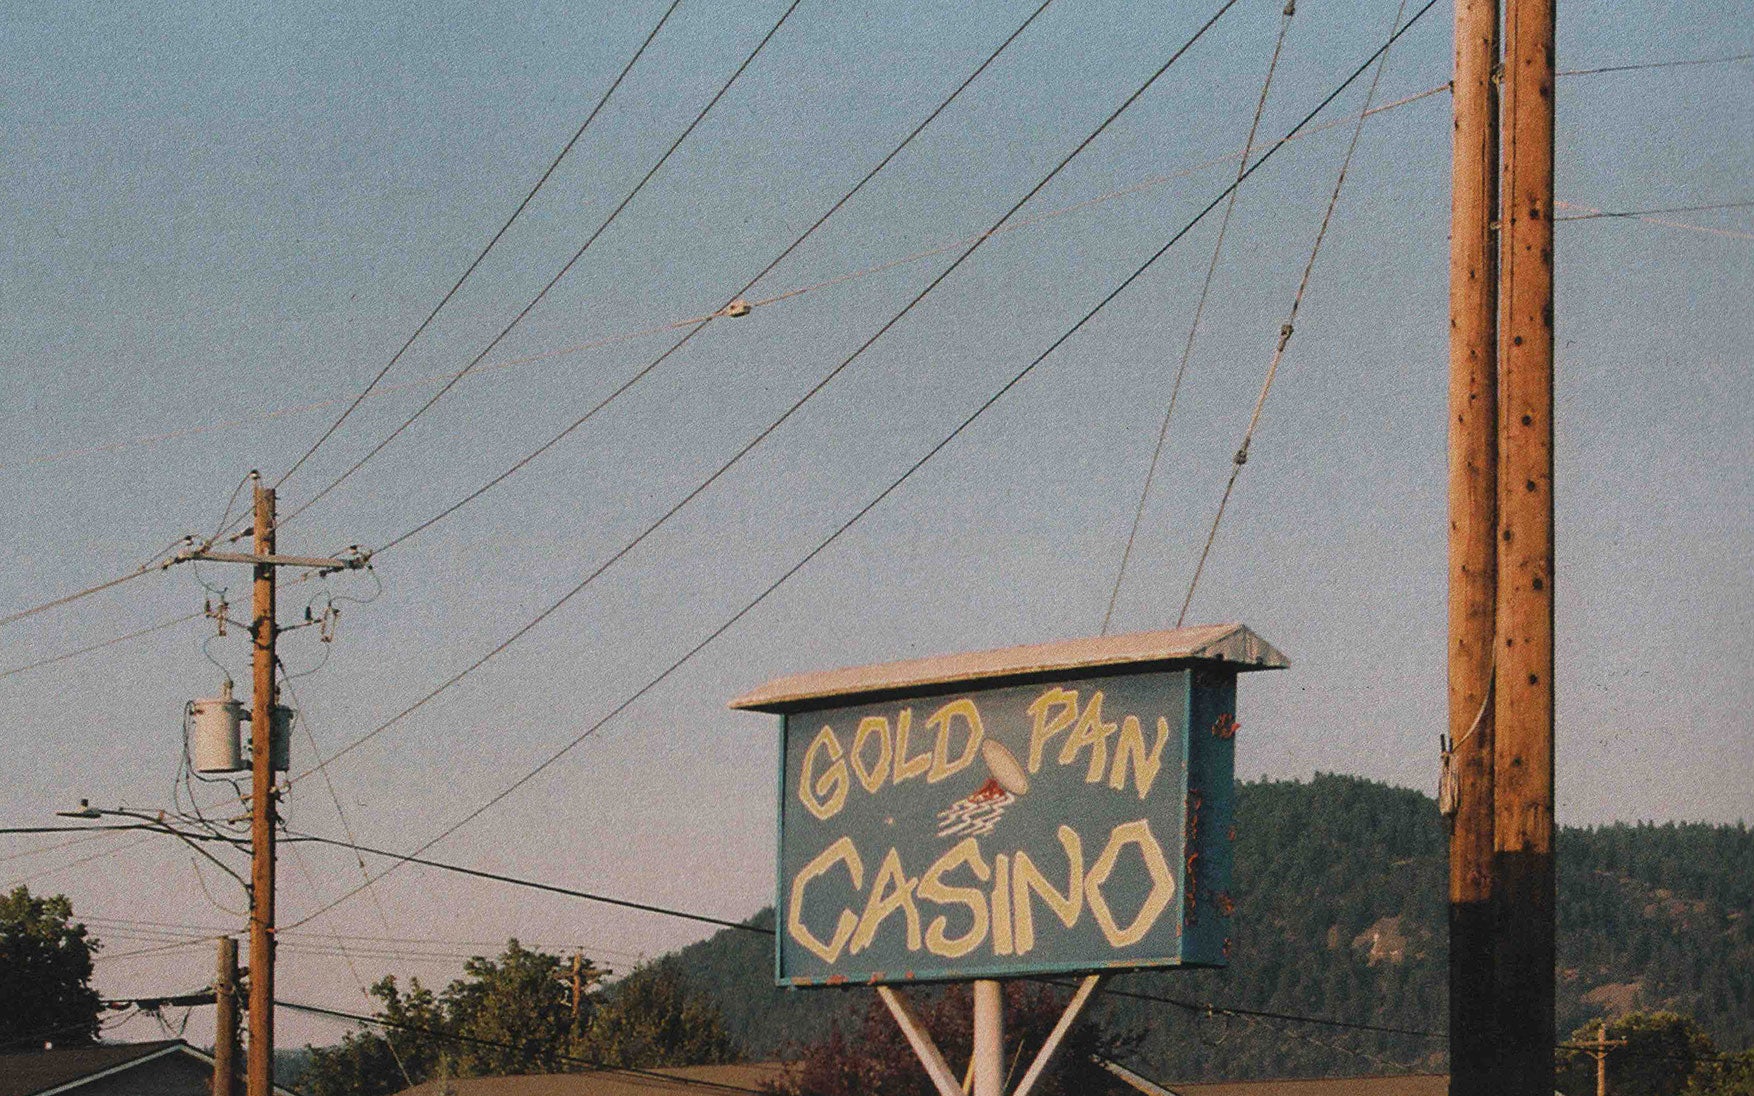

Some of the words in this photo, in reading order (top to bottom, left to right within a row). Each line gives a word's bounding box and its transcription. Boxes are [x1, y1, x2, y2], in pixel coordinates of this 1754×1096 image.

[800, 698, 984, 819] GOLD
[1027, 687, 1169, 799] PAN
[788, 819, 1174, 963] CASINO
